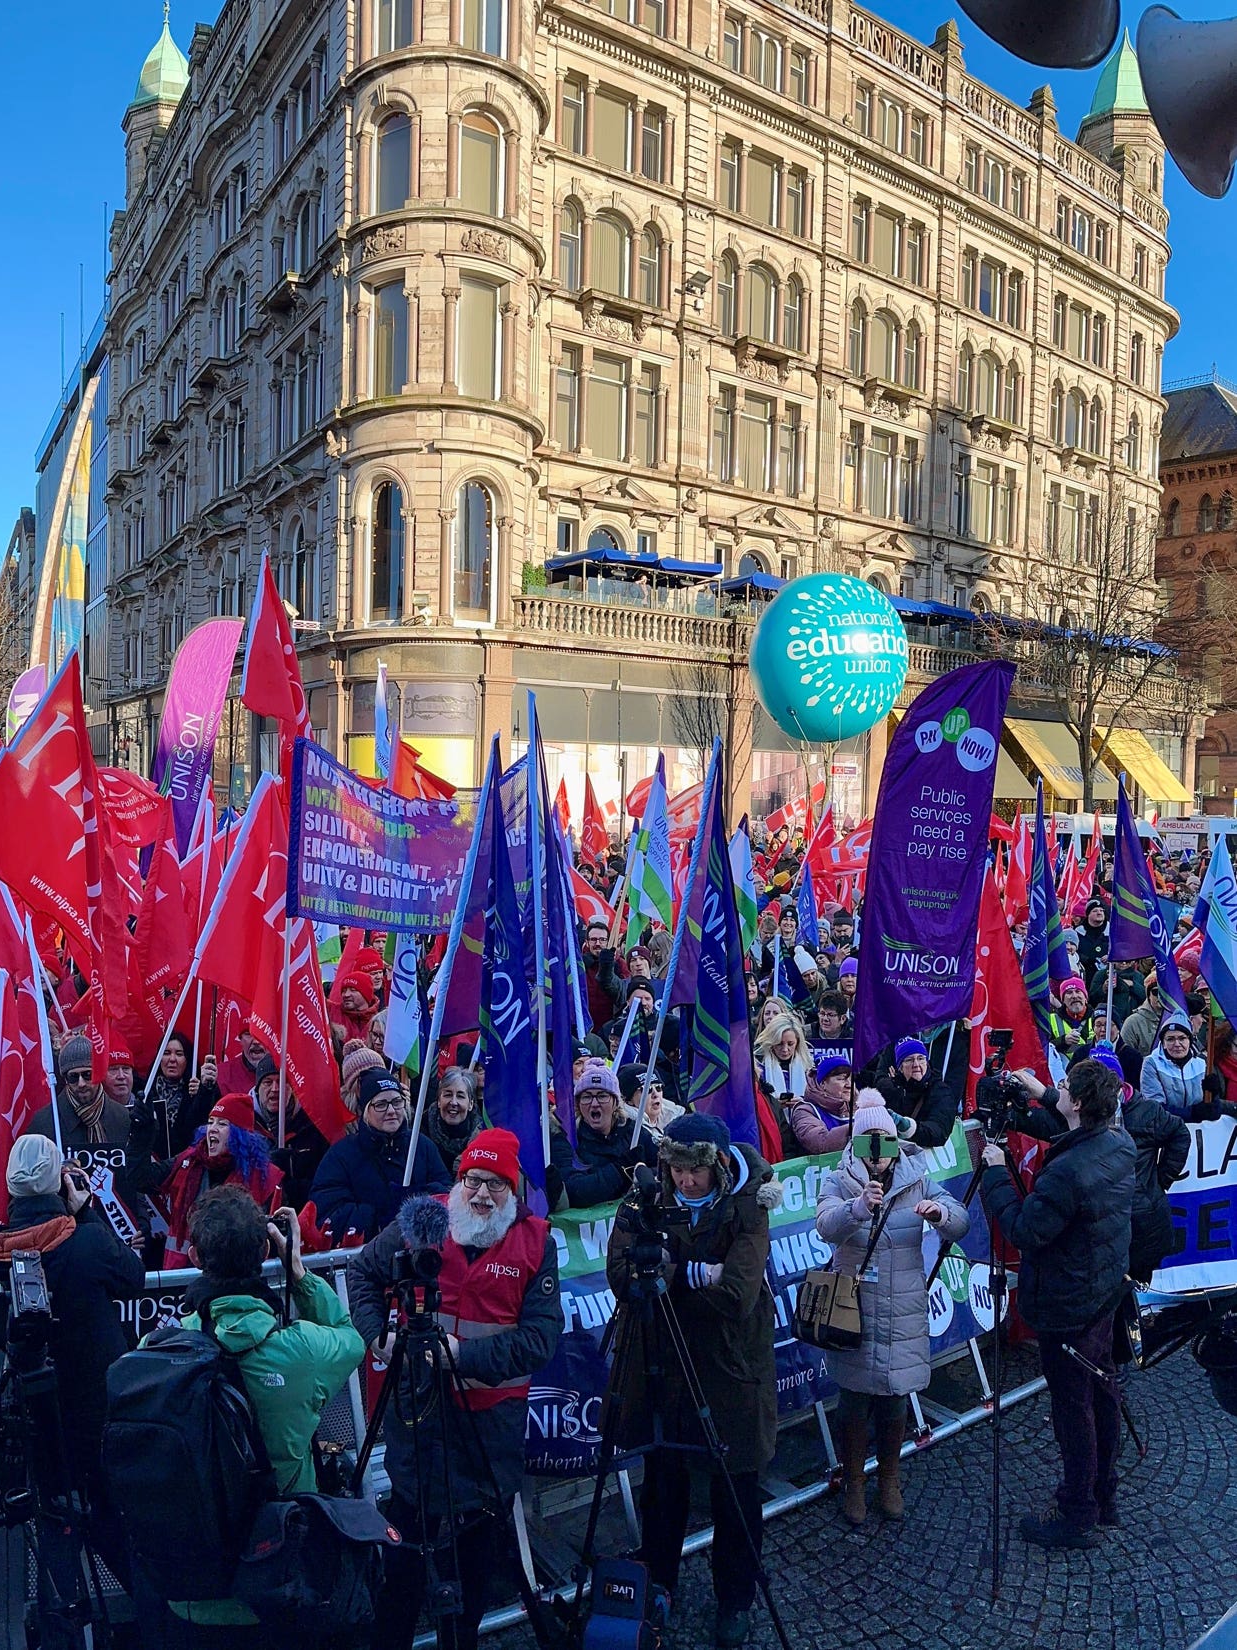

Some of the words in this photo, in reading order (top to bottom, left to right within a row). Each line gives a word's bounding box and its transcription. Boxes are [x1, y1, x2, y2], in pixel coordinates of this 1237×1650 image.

[827, 611, 894, 627] national
[787, 628, 908, 660] educatio
[844, 658, 891, 674] union
[944, 717, 965, 734] UP
[172, 713, 203, 800] UNISON
[194, 765, 205, 789] public
[200, 738, 211, 764] service
[206, 711, 216, 737] union
[960, 736, 992, 763] NOW!
[921, 785, 966, 806] Public
[910, 806, 972, 825] services
[913, 824, 951, 841] need
[954, 828, 965, 843] a
[1161, 821, 1205, 830] AMBULANCE
[907, 841, 936, 860] pay
[939, 845, 967, 860] rise
[884, 951, 960, 976] UNISON
[883, 976, 896, 985] the
[896, 976, 919, 987] public
[919, 979, 944, 988] service
[943, 979, 967, 988] union
[467, 1148, 498, 1161] nipsa
[770, 1228, 833, 1277] NHS
[485, 1262, 520, 1279] nipsa
[943, 1256, 965, 1292] UP
[928, 1287, 947, 1321] AY
[818, 1358, 829, 1378] A
[524, 1453, 583, 1470] rthern
